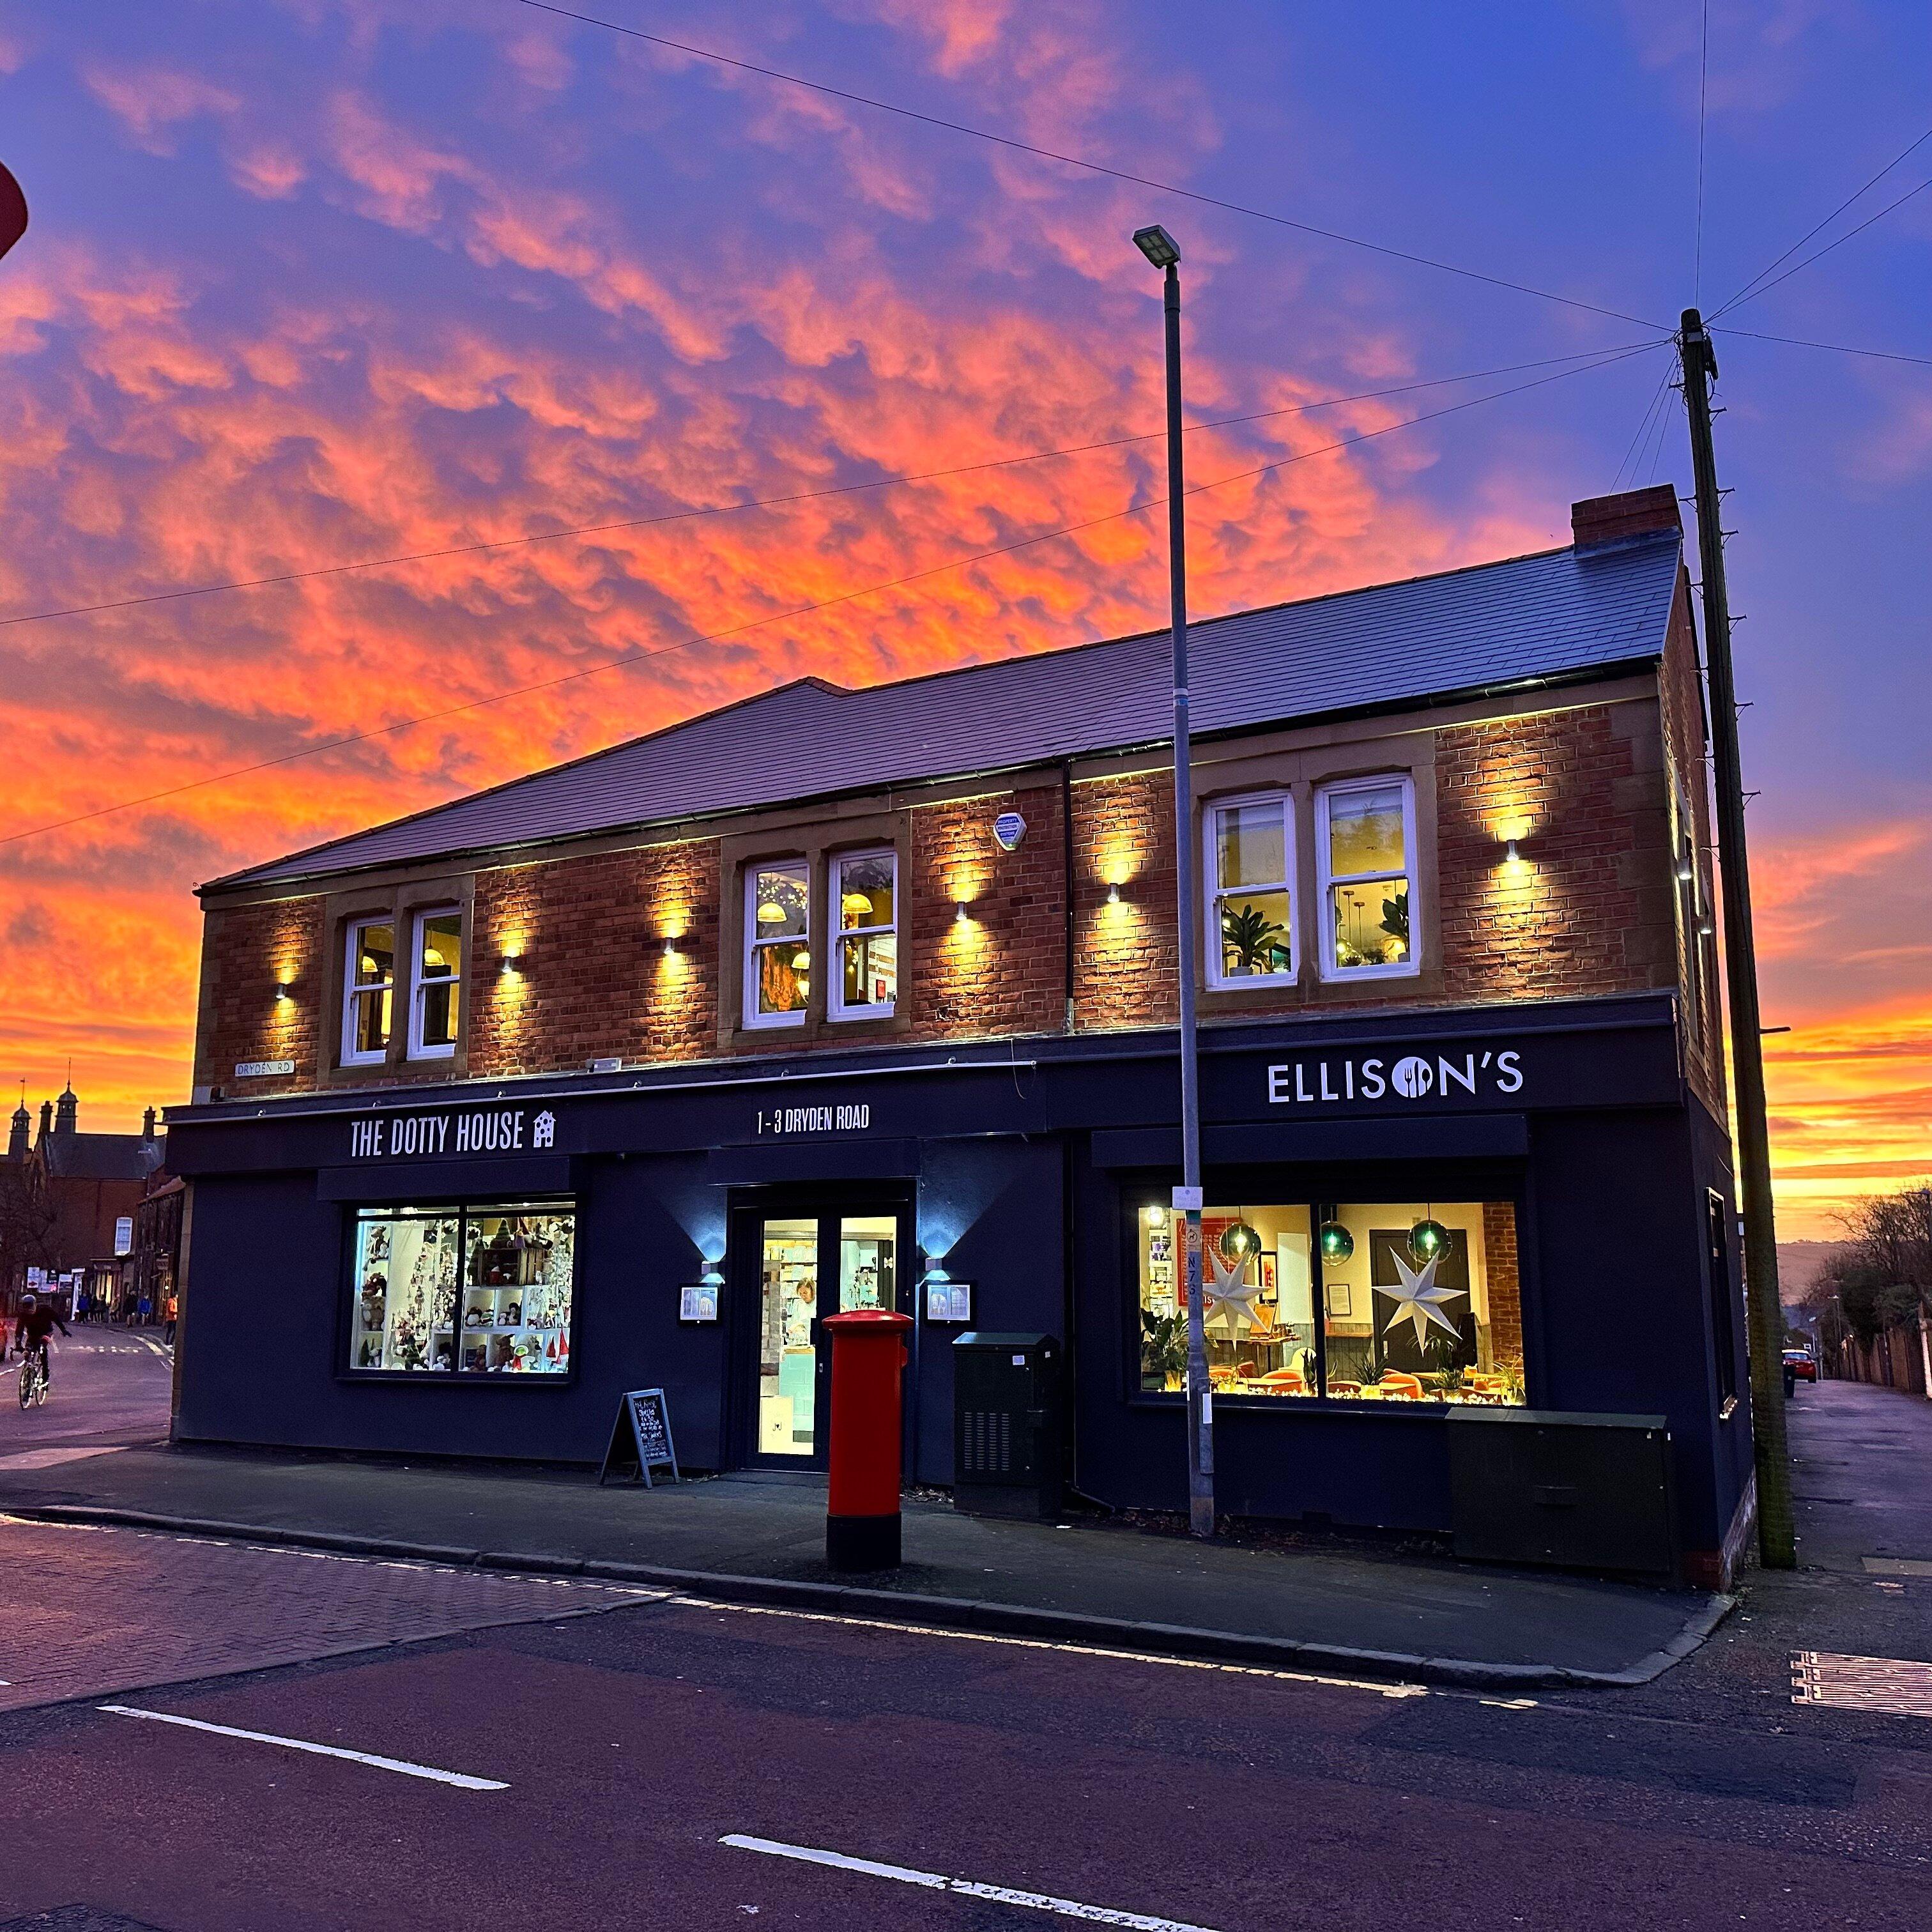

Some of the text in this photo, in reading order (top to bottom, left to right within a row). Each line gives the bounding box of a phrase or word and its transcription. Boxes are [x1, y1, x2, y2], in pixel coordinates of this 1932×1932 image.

[238, 1062, 290, 1075] DRYDEN RD
[1268, 1051, 1523, 1103] ELLISON'S
[351, 1111, 524, 1157] THE DOTTY HOUSE
[785, 1107, 832, 1133] DRYDEN
[836, 1104, 870, 1130] ROAD
